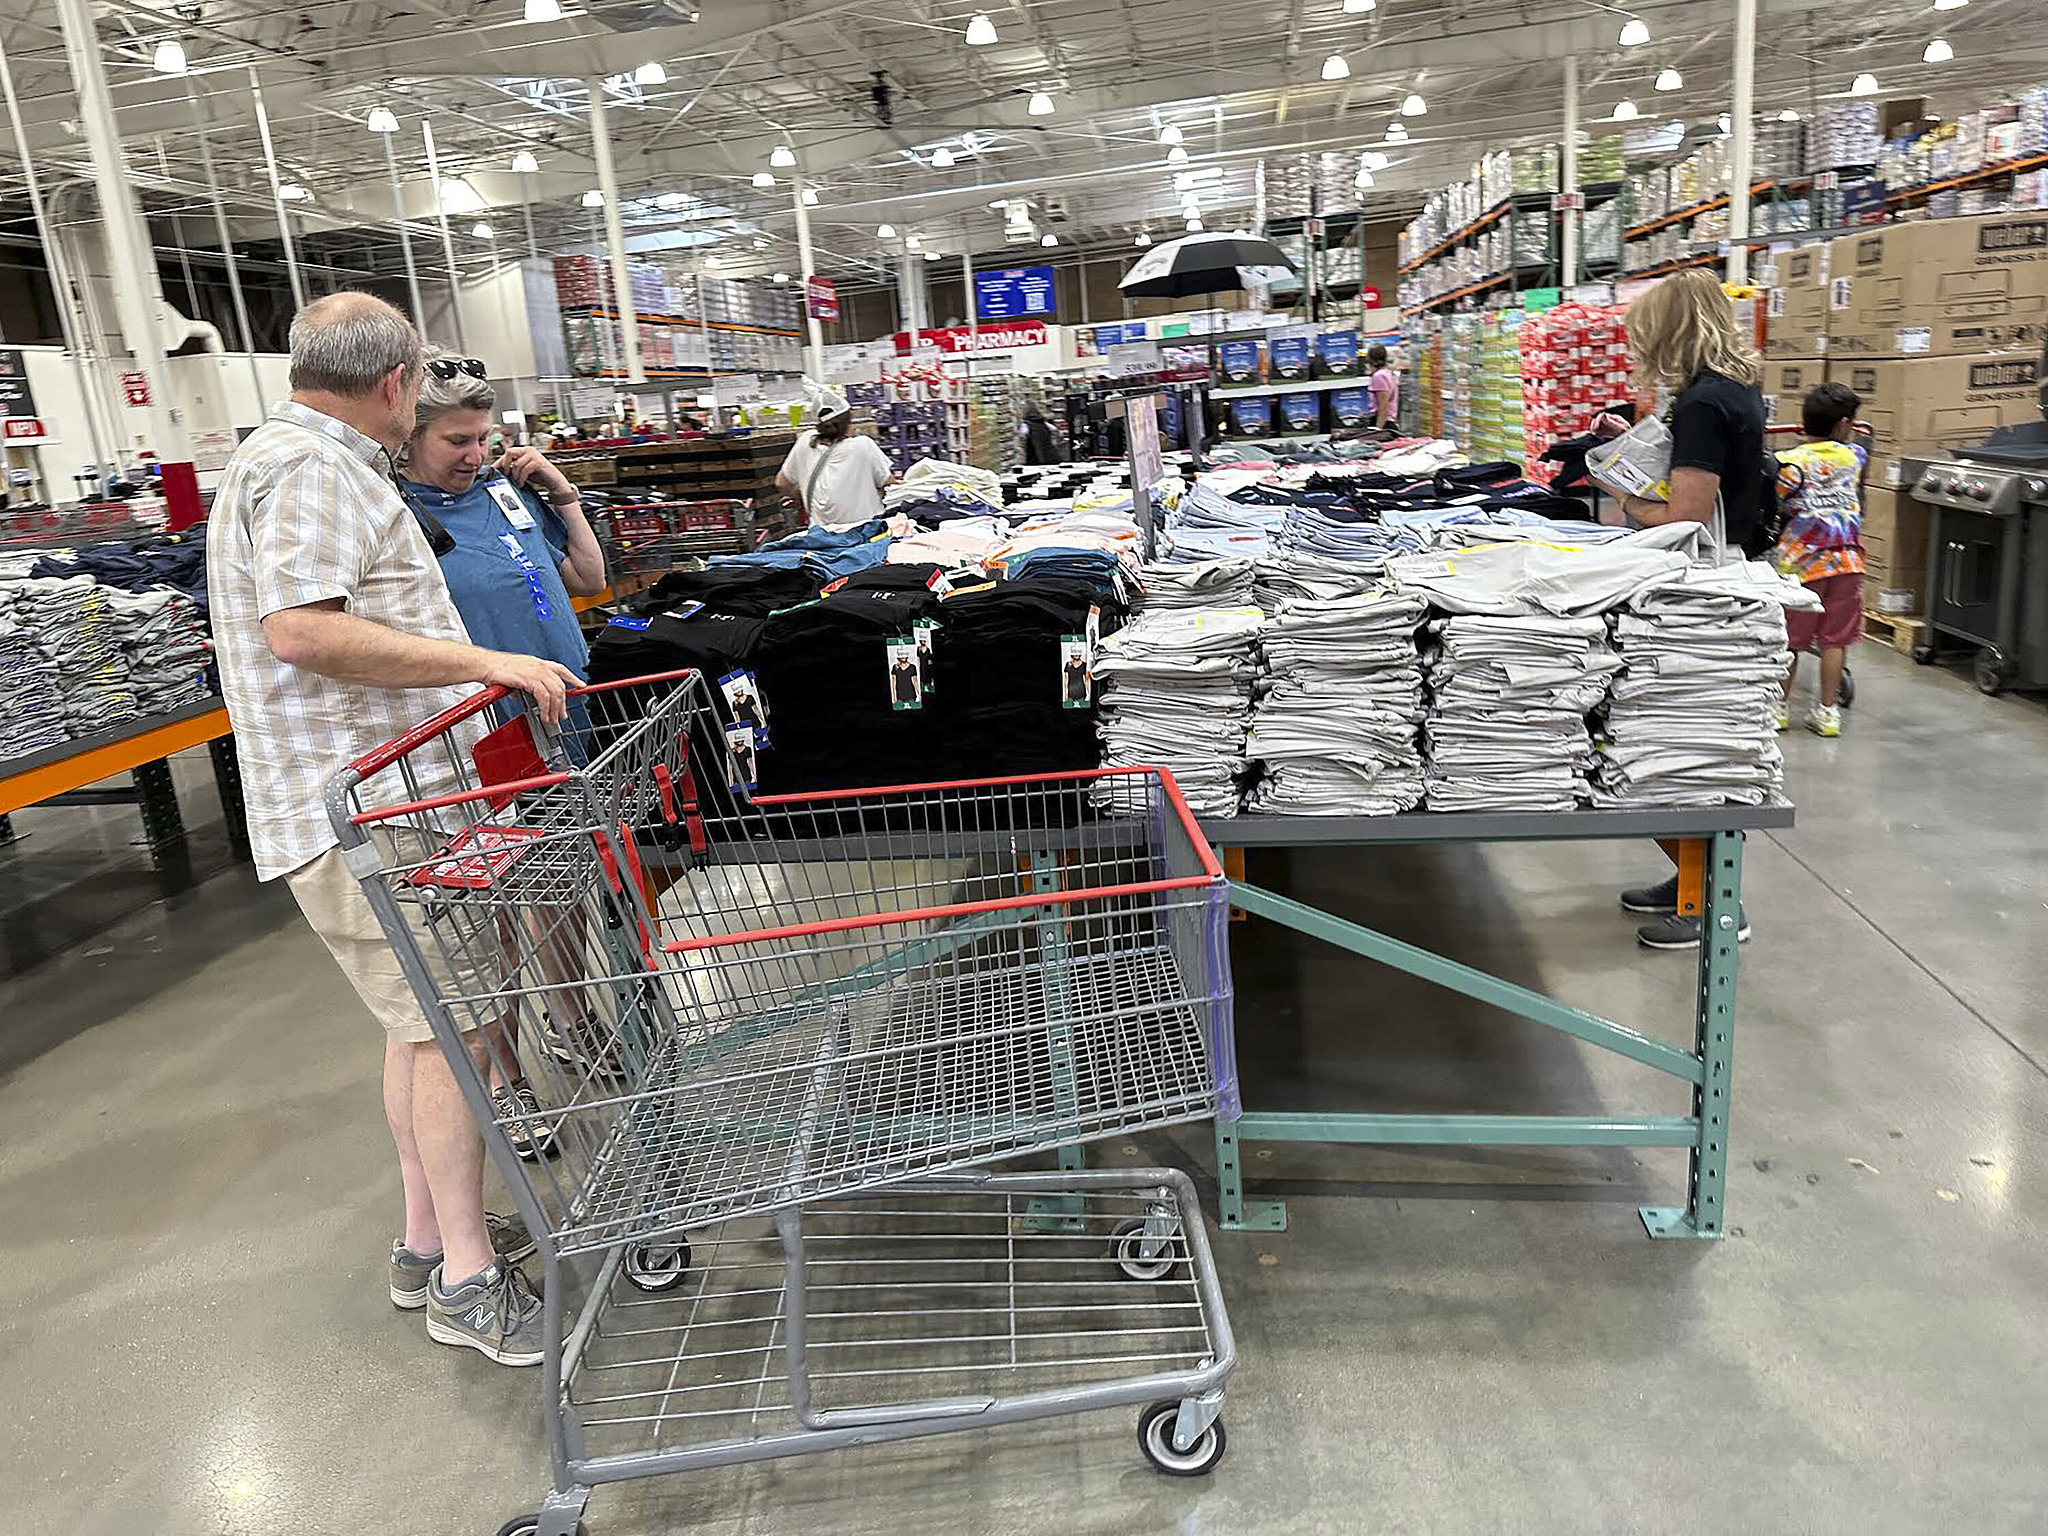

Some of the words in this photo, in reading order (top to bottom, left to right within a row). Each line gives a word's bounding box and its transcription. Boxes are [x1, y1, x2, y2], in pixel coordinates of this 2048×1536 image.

[1974, 252, 2037, 266] GENESIS
[953, 328, 1046, 351] PHARMACY
[463, 1303, 496, 1330] N
